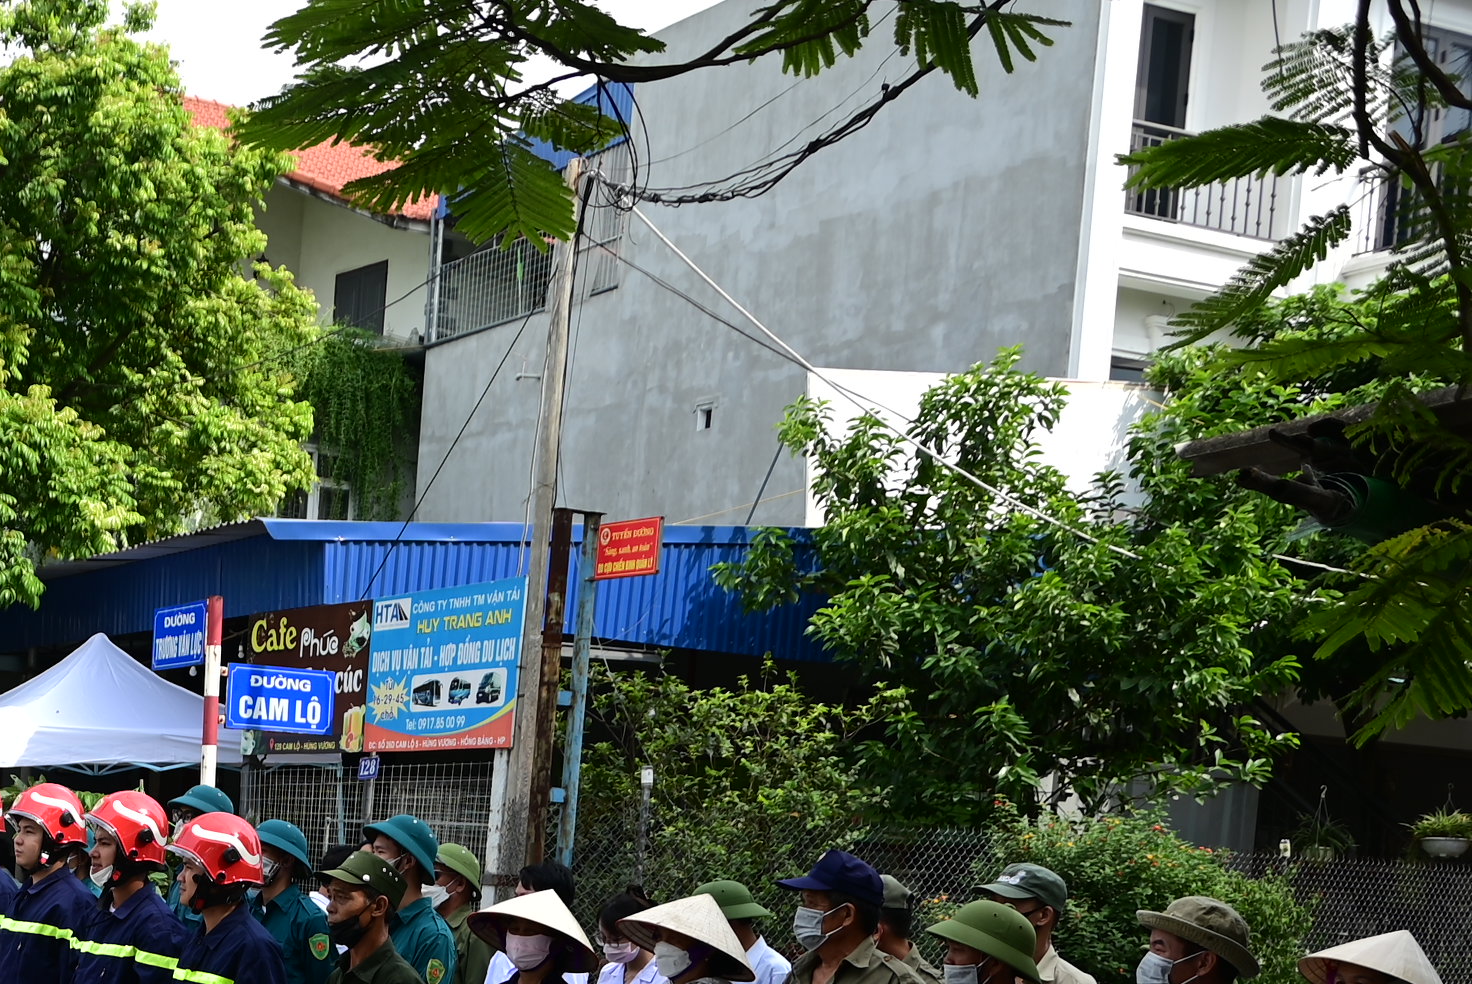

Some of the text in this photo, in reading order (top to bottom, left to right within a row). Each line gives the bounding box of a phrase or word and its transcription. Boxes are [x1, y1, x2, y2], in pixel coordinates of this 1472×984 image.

[413, 601, 436, 614] CÔNG
[437, 600, 448, 611] TY
[449, 597, 471, 609] TNHH
[473, 594, 486, 605] TM
[488, 590, 504, 606] VẬN
[164, 611, 195, 628] ĐƯỜNG
[376, 603, 406, 624] HTA
[416, 608, 512, 634] HUY TRANG ANH
[251, 617, 339, 658] Cafe Phúc
[372, 650, 390, 677] DỊCH
[391, 649, 402, 675] VỤ
[403, 644, 419, 674] VẬN
[420, 637, 433, 669] TẢI
[439, 641, 456, 671] HỢP
[457, 634, 481, 665] ĐỒNG
[482, 639, 495, 662] DU
[496, 637, 516, 666] LỊCH
[250, 674, 311, 692] ĐƯỜNG
[334, 665, 363, 694] cúc
[373, 694, 405, 705] 16-29-45
[239, 695, 321, 729] CAM LỘ
[406, 716, 466, 730] Tel: 0917.85 00 99
[360, 760, 376, 775] 128
